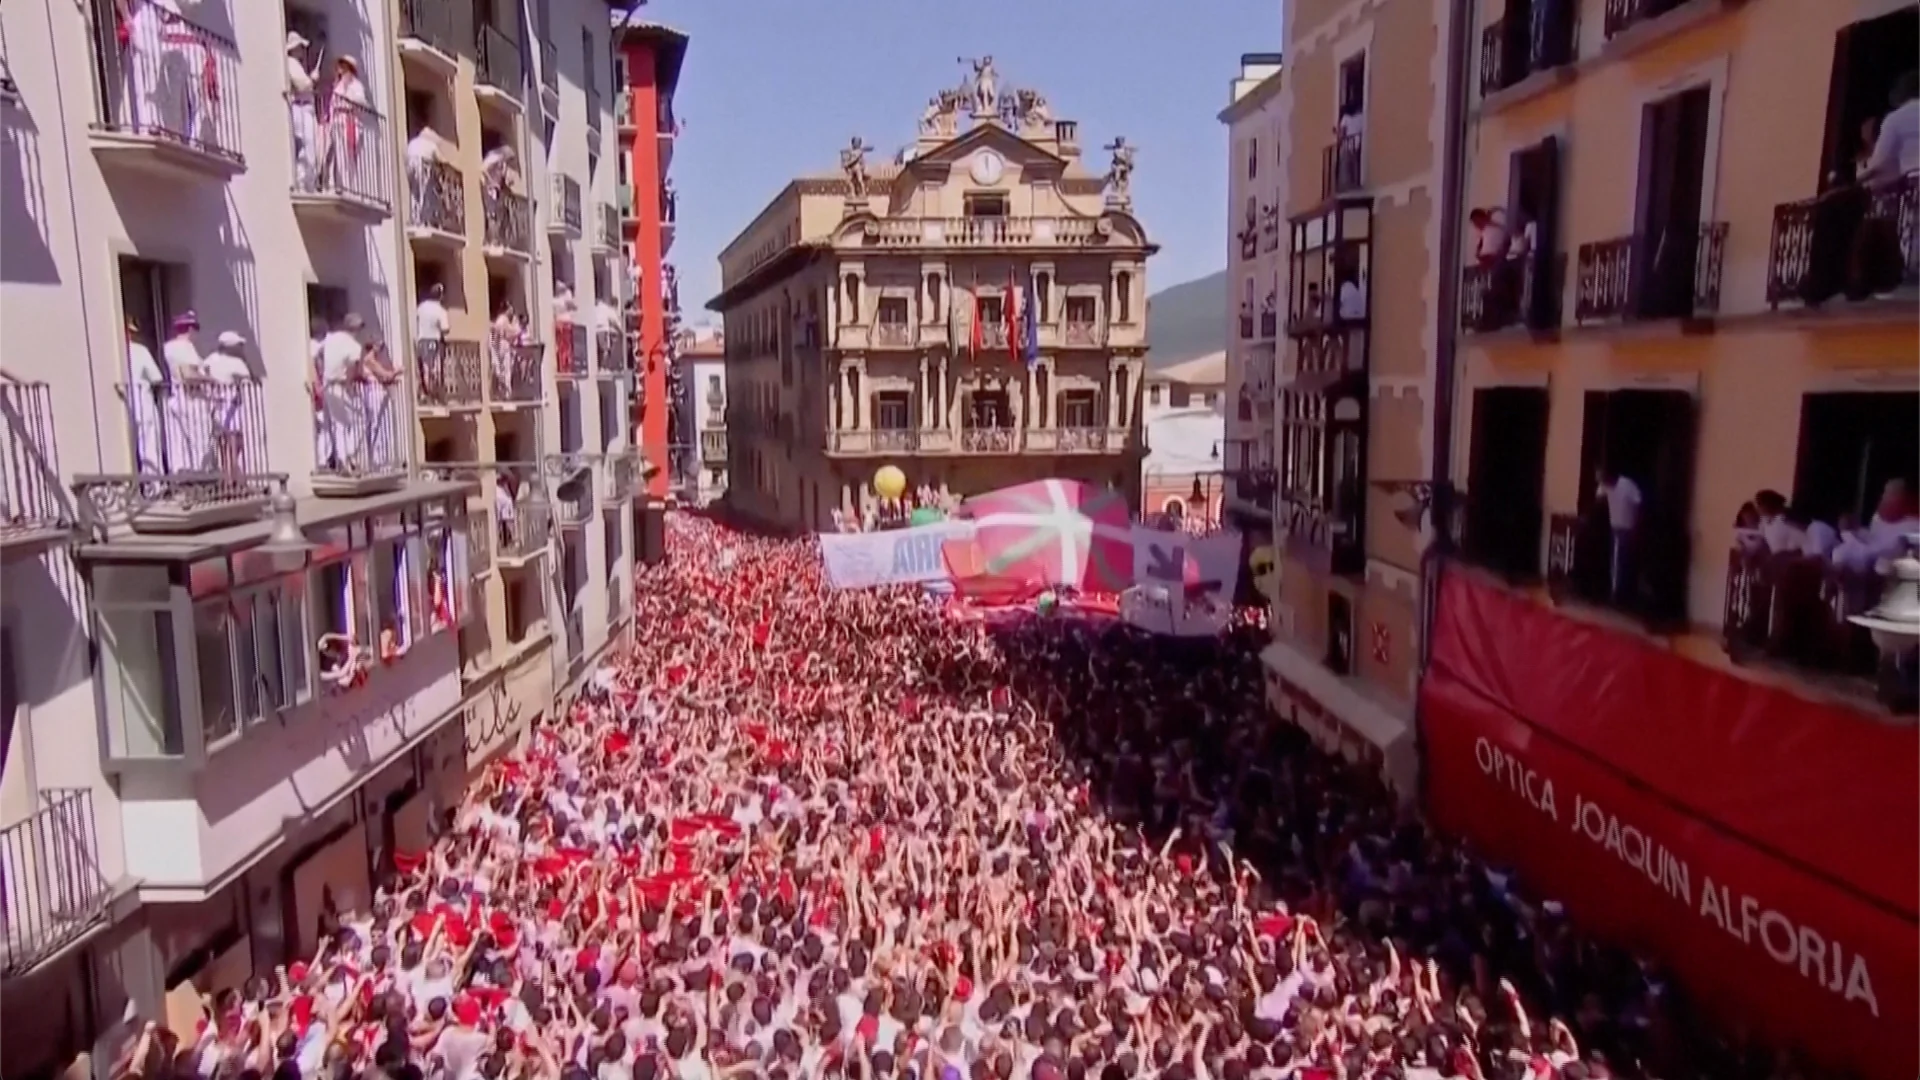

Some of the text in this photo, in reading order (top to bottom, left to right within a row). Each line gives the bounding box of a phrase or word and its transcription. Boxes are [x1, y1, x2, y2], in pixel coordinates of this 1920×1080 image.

[1475, 736, 1880, 1017] OPTICA JOAQUIN ALFORJA
